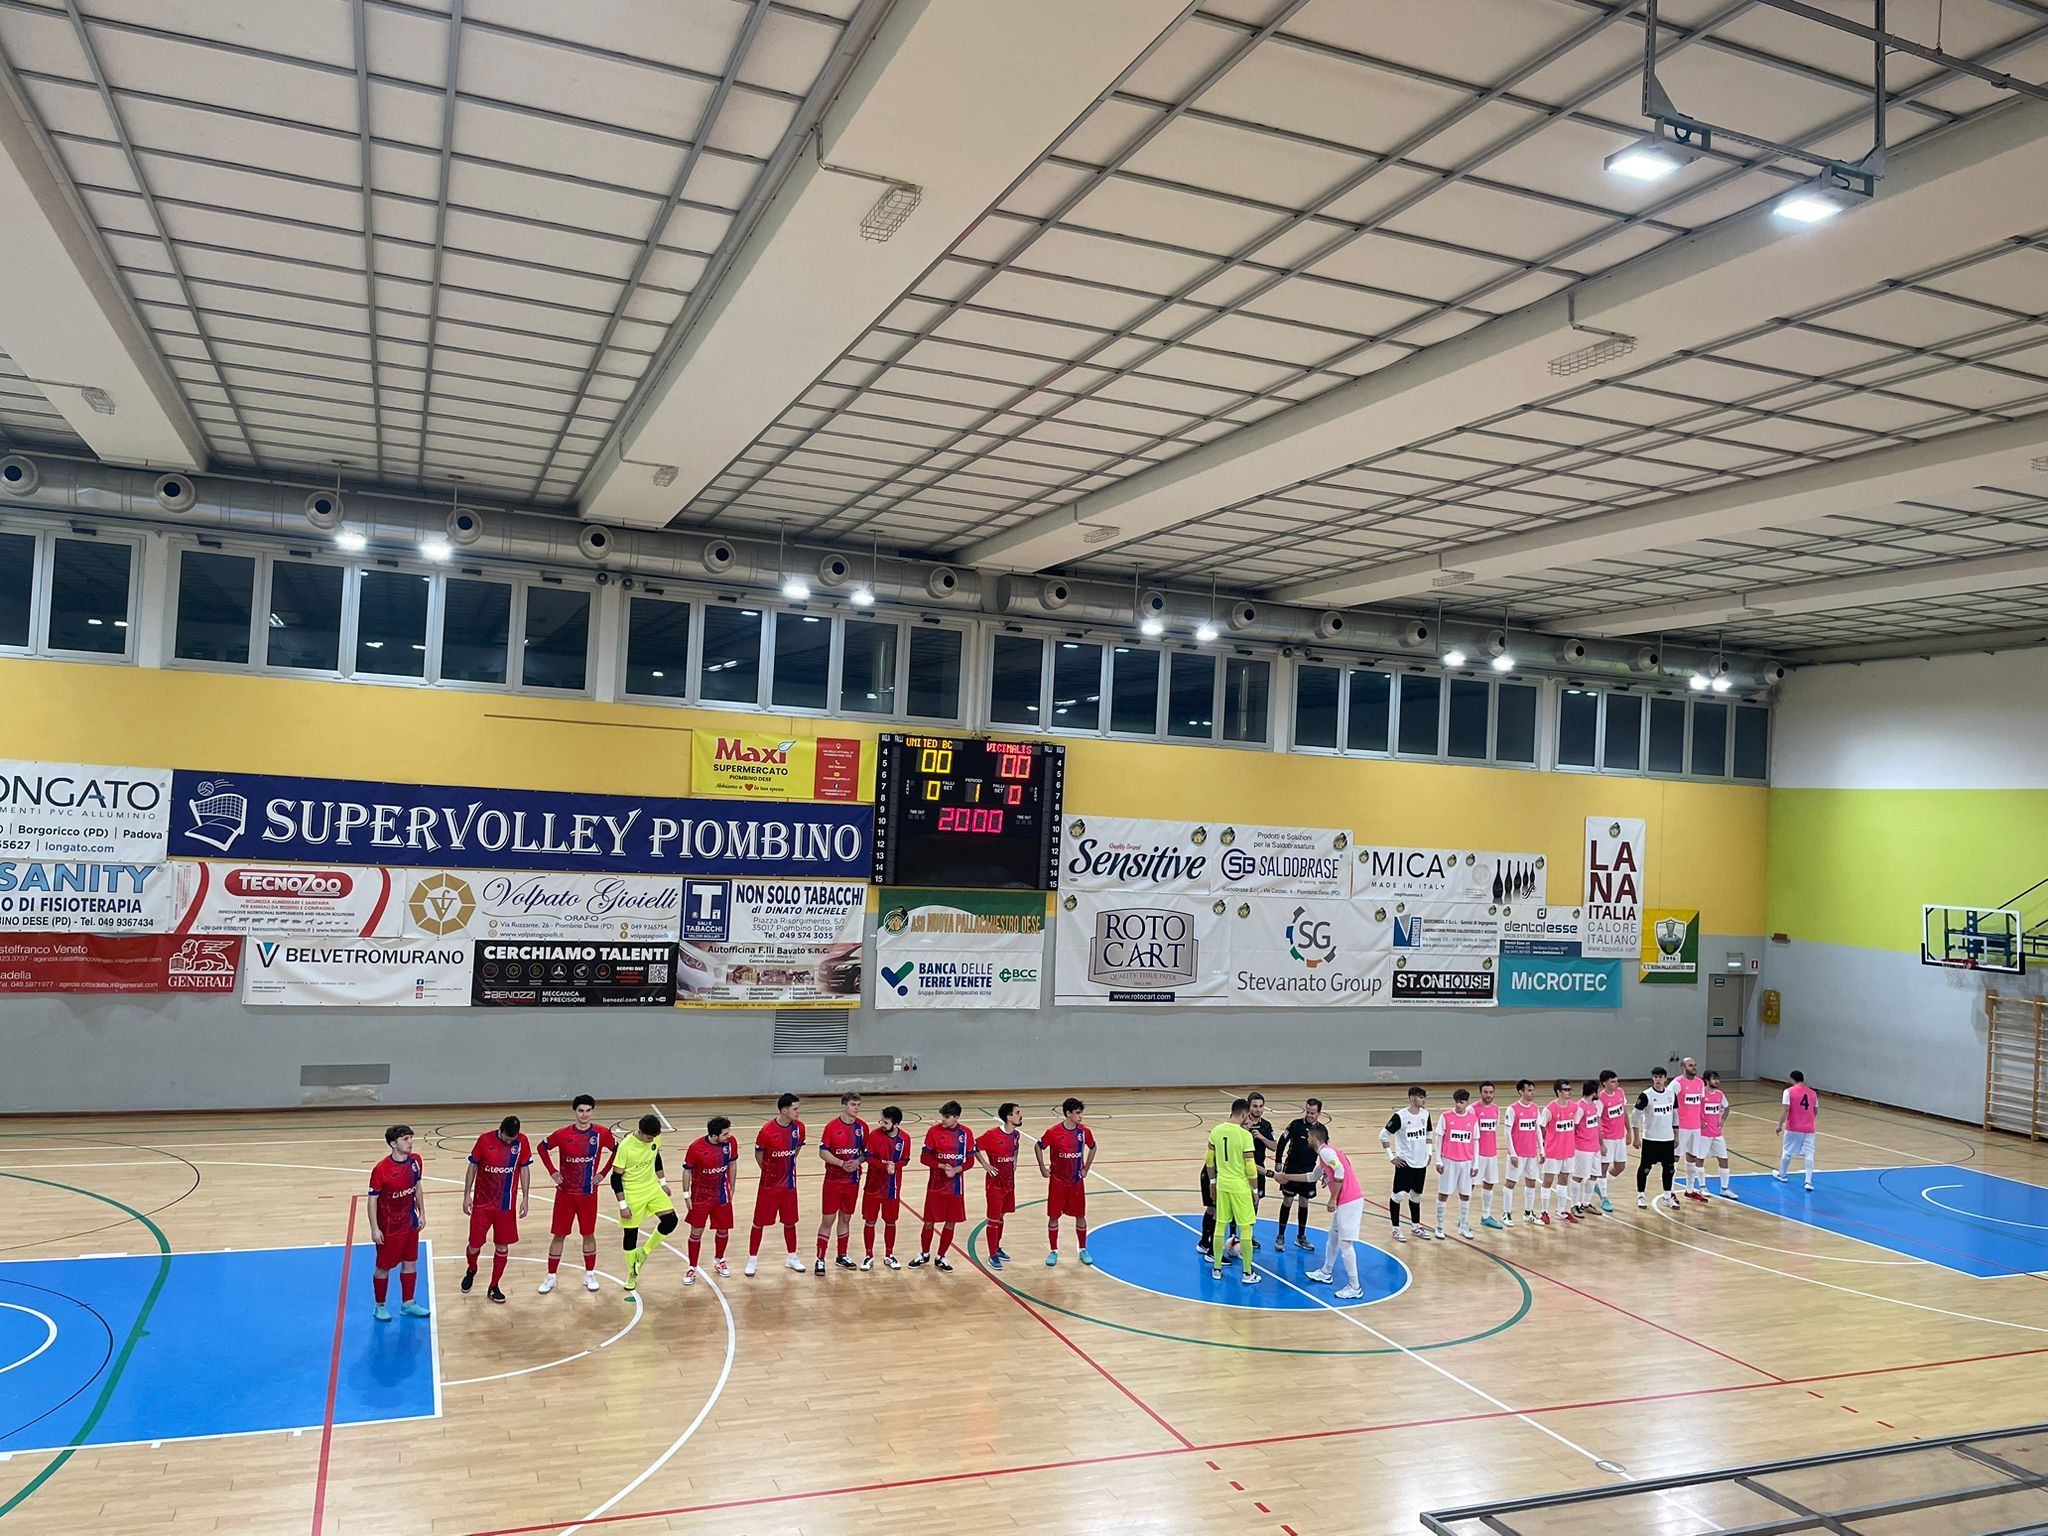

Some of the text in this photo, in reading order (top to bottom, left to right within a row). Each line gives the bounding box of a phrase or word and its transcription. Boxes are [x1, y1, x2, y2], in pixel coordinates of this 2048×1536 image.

[714, 738, 788, 764] Maxi
[906, 738, 937, 748] UNITED
[942, 740, 953, 749] BC
[921, 749, 952, 773] 00
[1001, 754, 1031, 778] 00
[713, 764, 788, 776] SUPERMERCATO
[927, 781, 941, 800] 0
[975, 783, 980, 802] 1
[1008, 785, 1021, 804] 0
[50, 809, 155, 820] PVC ALLUMINIO
[878, 817, 886, 825] 10
[938, 807, 1003, 833] 2000
[18, 824, 163, 840] Borgoricco (PD) Padova
[262, 798, 863, 862] SUPERVOLLEY PIOMBINO
[1257, 832, 1279, 840] Prodotti
[45, 841, 115, 853] longato.com
[1272, 842, 1315, 850] Saldobrasatura
[1068, 838, 1206, 883] Sensitive
[1259, 856, 1339, 879] SALDOBRASE
[1372, 851, 1445, 879] MICA
[239, 872, 341, 896] TECNOZOO
[1589, 872, 1637, 904] NA
[482, 876, 679, 915] Volpato Gioielli
[692, 885, 722, 919] T
[736, 884, 864, 906] NON SOLO TABACCHI
[19, 897, 142, 914] DI FISIOTERAPIA
[751, 906, 848, 916] di DINATO MICHELE
[1589, 905, 1636, 921] ITALIA
[23, 917, 154, 928] DESE (PD) Tel. 049 9367434
[780, 917, 831, 925] Risorgimento,
[1021, 916, 1040, 934] DESE
[1105, 914, 1186, 940] ROTO
[1504, 921, 1577, 933] dentalesse
[1588, 922, 1637, 934] CALORE
[764, 931, 777, 939] Tel.
[1298, 921, 1331, 949] SG
[1587, 934, 1637, 945] ITALIANO
[53, 945, 88, 954] Veneto
[286, 948, 464, 965] BELVETROMURANO
[484, 946, 669, 961] CERCHIAMO TALENTI
[707, 945, 756, 954] Autofficina
[777, 946, 806, 955] Bavato
[807, 946, 830, 955] s.n.c.
[1103, 942, 1185, 968] CART
[919, 963, 993, 975] BANCA DELLE
[1012, 969, 1037, 978] BCC
[1110, 972, 1137, 980] QUALITY
[168, 975, 233, 988] GENERALI
[919, 976, 992, 988] TERRE VENETE
[1237, 971, 1382, 996] Stevanato Group
[492, 991, 535, 999] BENOZZI
[1800, 1093, 1809, 1110] 4
[1223, 1136, 1229, 1162] 1
